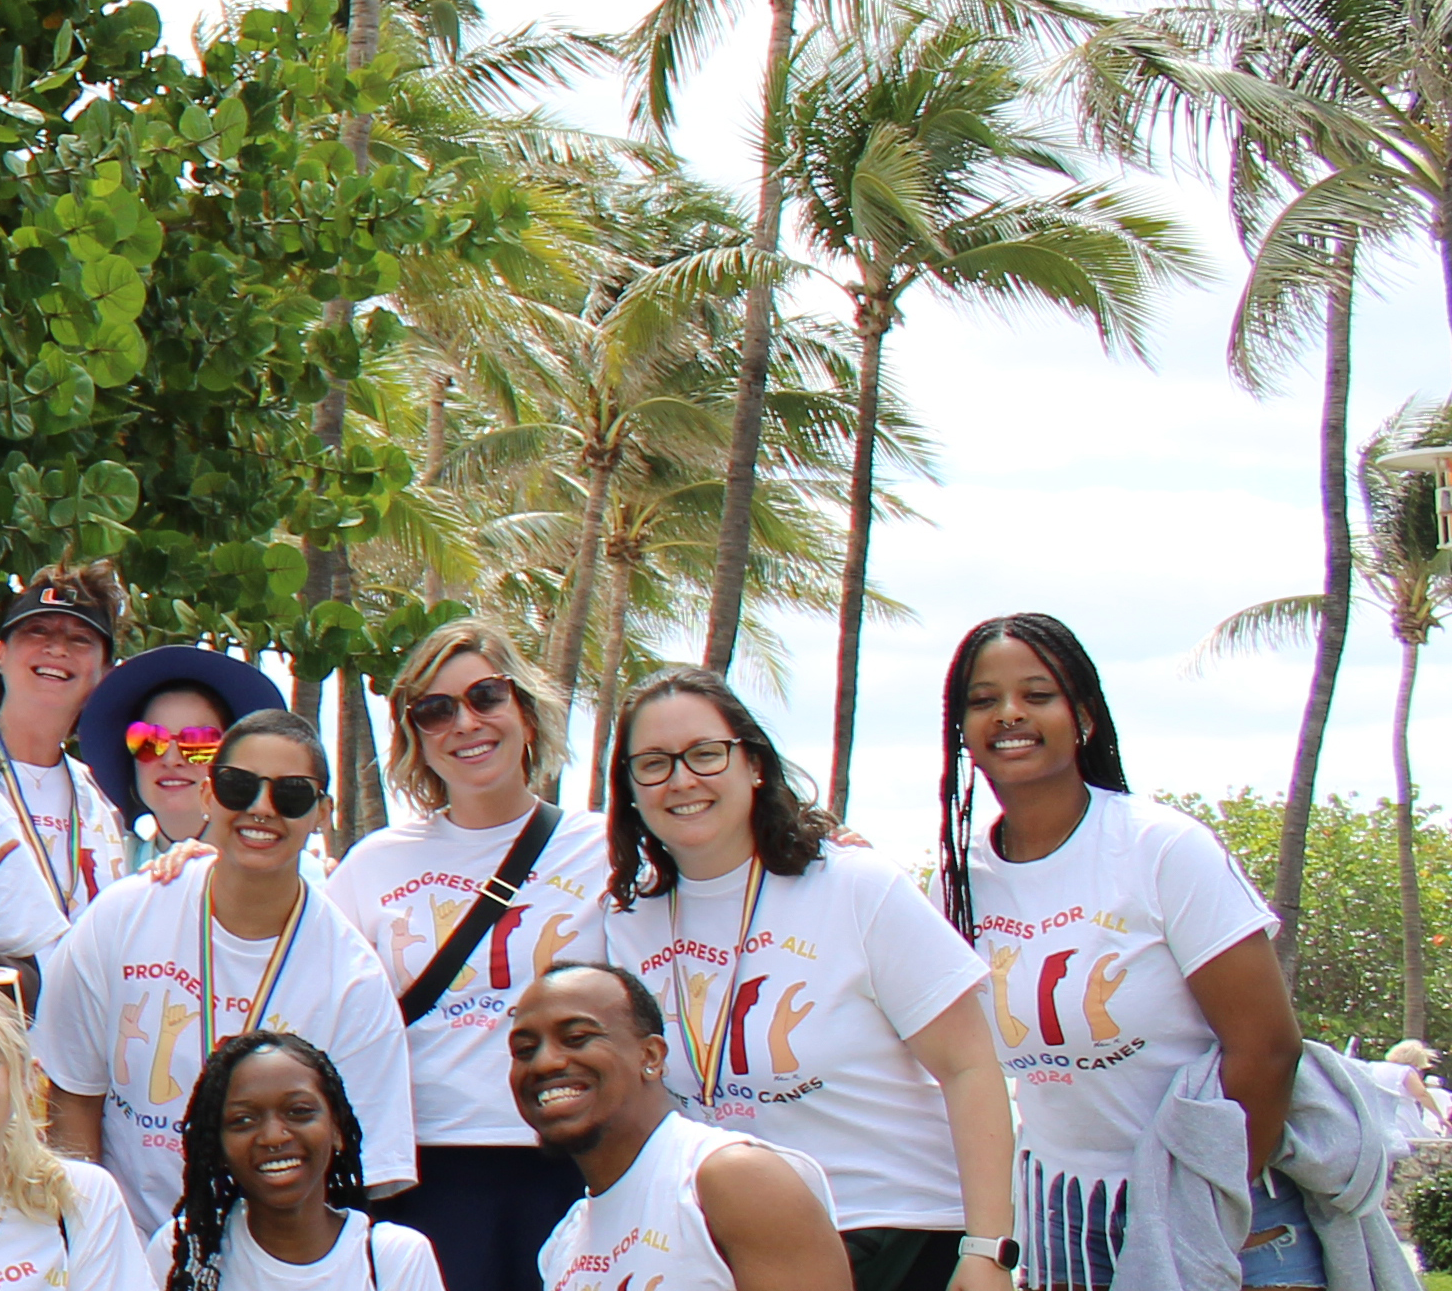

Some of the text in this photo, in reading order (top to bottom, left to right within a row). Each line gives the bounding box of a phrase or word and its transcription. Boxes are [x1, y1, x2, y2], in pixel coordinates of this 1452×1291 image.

[546, 874, 585, 900] ALL
[1041, 905, 1129, 935] FOR ALL
[641, 936, 818, 975] PROGRESS ALL
[478, 997, 504, 1012] GO
[451, 1014, 498, 1031] 2024
[1005, 1053, 1036, 1070] YOU
[1039, 1052, 1069, 1068] GO
[1076, 1037, 1146, 1071] CANES
[727, 1076, 823, 1105] GO CANES
[1027, 1070, 1073, 1085] 2024
[135, 1112, 167, 1130] YOU
[715, 1103, 756, 1120] 2024
[612, 1226, 640, 1263] FOR
[642, 1228, 670, 1252] ALL
